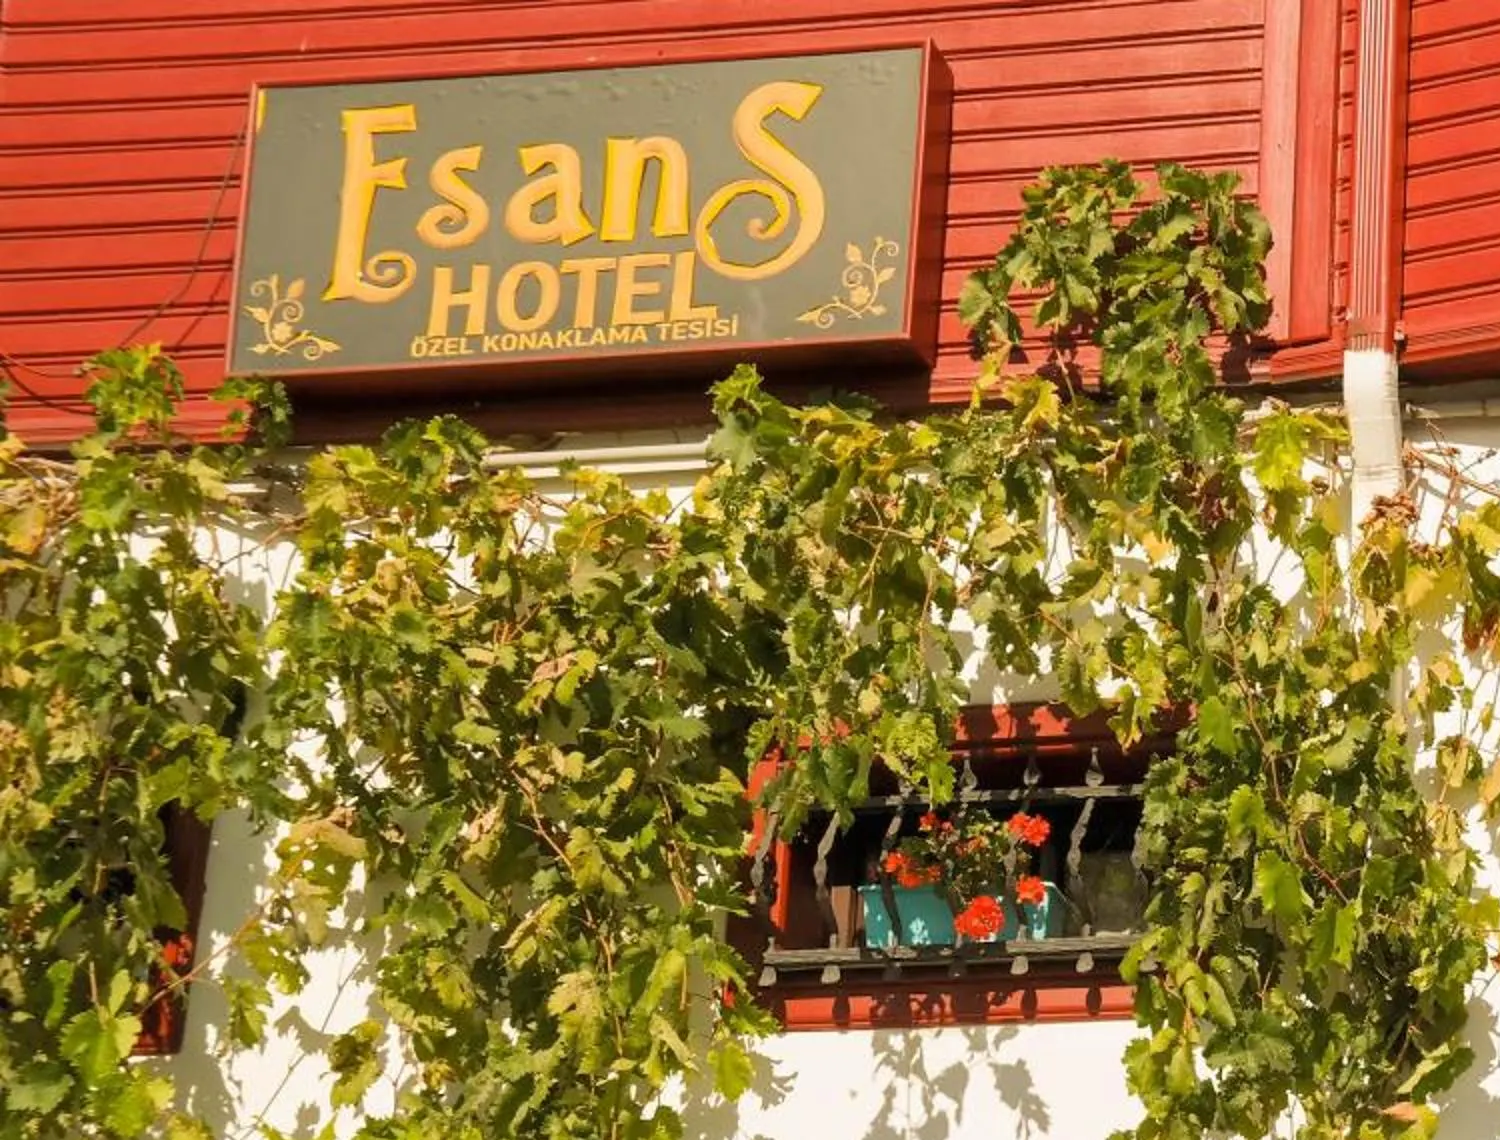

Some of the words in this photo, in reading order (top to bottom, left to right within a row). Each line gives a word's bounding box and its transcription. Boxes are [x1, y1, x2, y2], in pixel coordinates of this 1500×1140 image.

[427, 251, 720, 337] HOTEL
[410, 335, 474, 358] ÖZEL
[482, 322, 647, 353] KONAKLAMA
